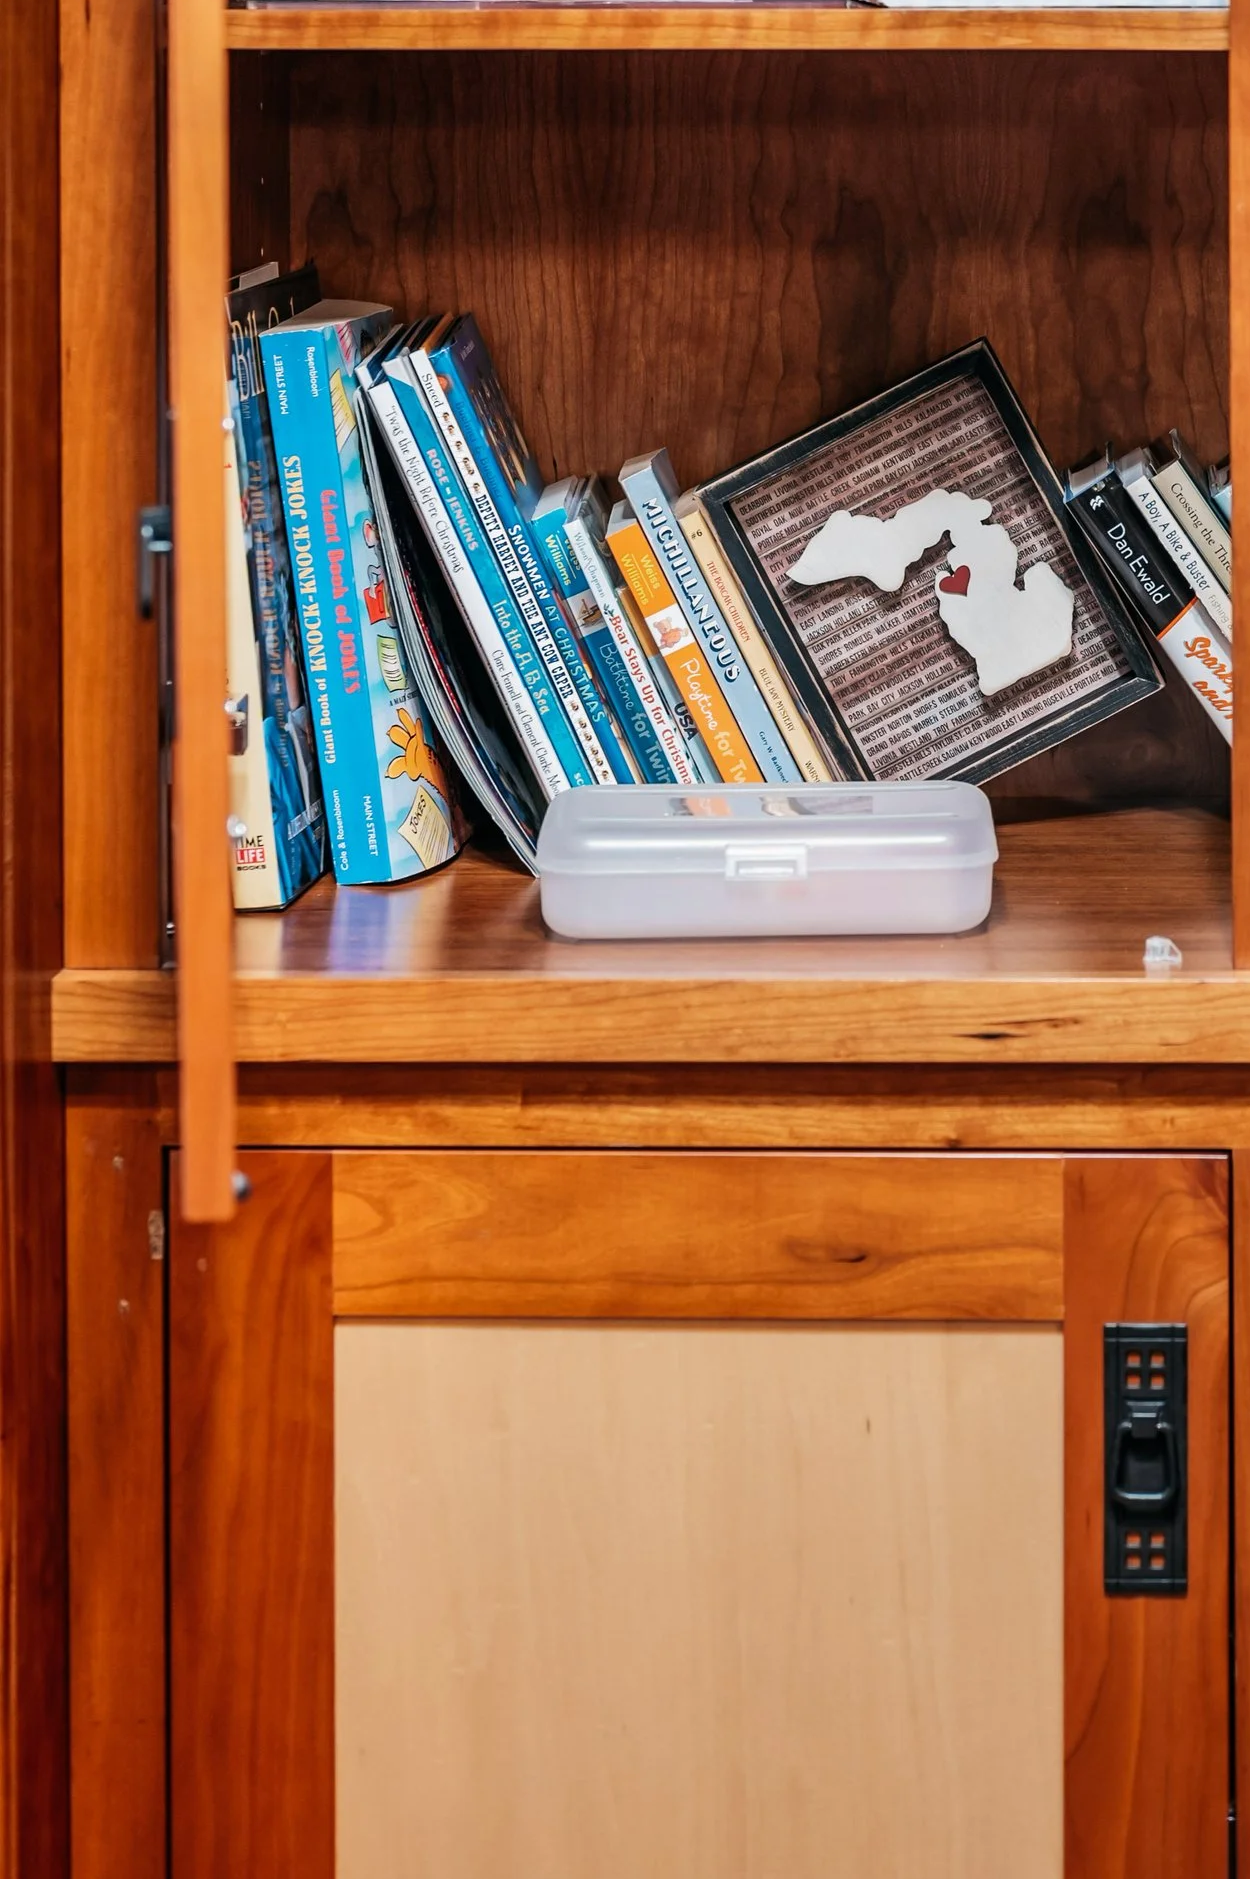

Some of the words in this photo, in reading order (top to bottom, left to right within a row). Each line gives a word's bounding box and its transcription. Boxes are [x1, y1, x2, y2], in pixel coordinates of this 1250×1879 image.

[273, 354, 286, 388] STREET
[304, 346, 319, 397] Rosenbloom
[280, 389, 289, 415] MAIN
[283, 454, 308, 520] JOKES
[545, 534, 570, 586] Williams
[640, 554, 662, 591] Weiss
[1108, 523, 1133, 560] Dan
[1128, 554, 1170, 605] Ewald
[291, 524, 328, 672] KNOCK-KNOCK
[621, 553, 649, 606] Williams
[642, 498, 741, 683] MICHILLANEOUS
[507, 524, 550, 598] SNOWMEN
[545, 605, 560, 623] AT
[554, 627, 606, 722] CHRISTMAS
[319, 677, 328, 692] of
[320, 694, 331, 727] Book
[674, 702, 698, 741] USA
[324, 729, 337, 764] Giant
[332, 790, 345, 840] Rosenbloom
[363, 796, 373, 820] MAIN
[237, 849, 265, 863] LIFE
[365, 822, 379, 856] STREET
[340, 851, 350, 872] Cole
